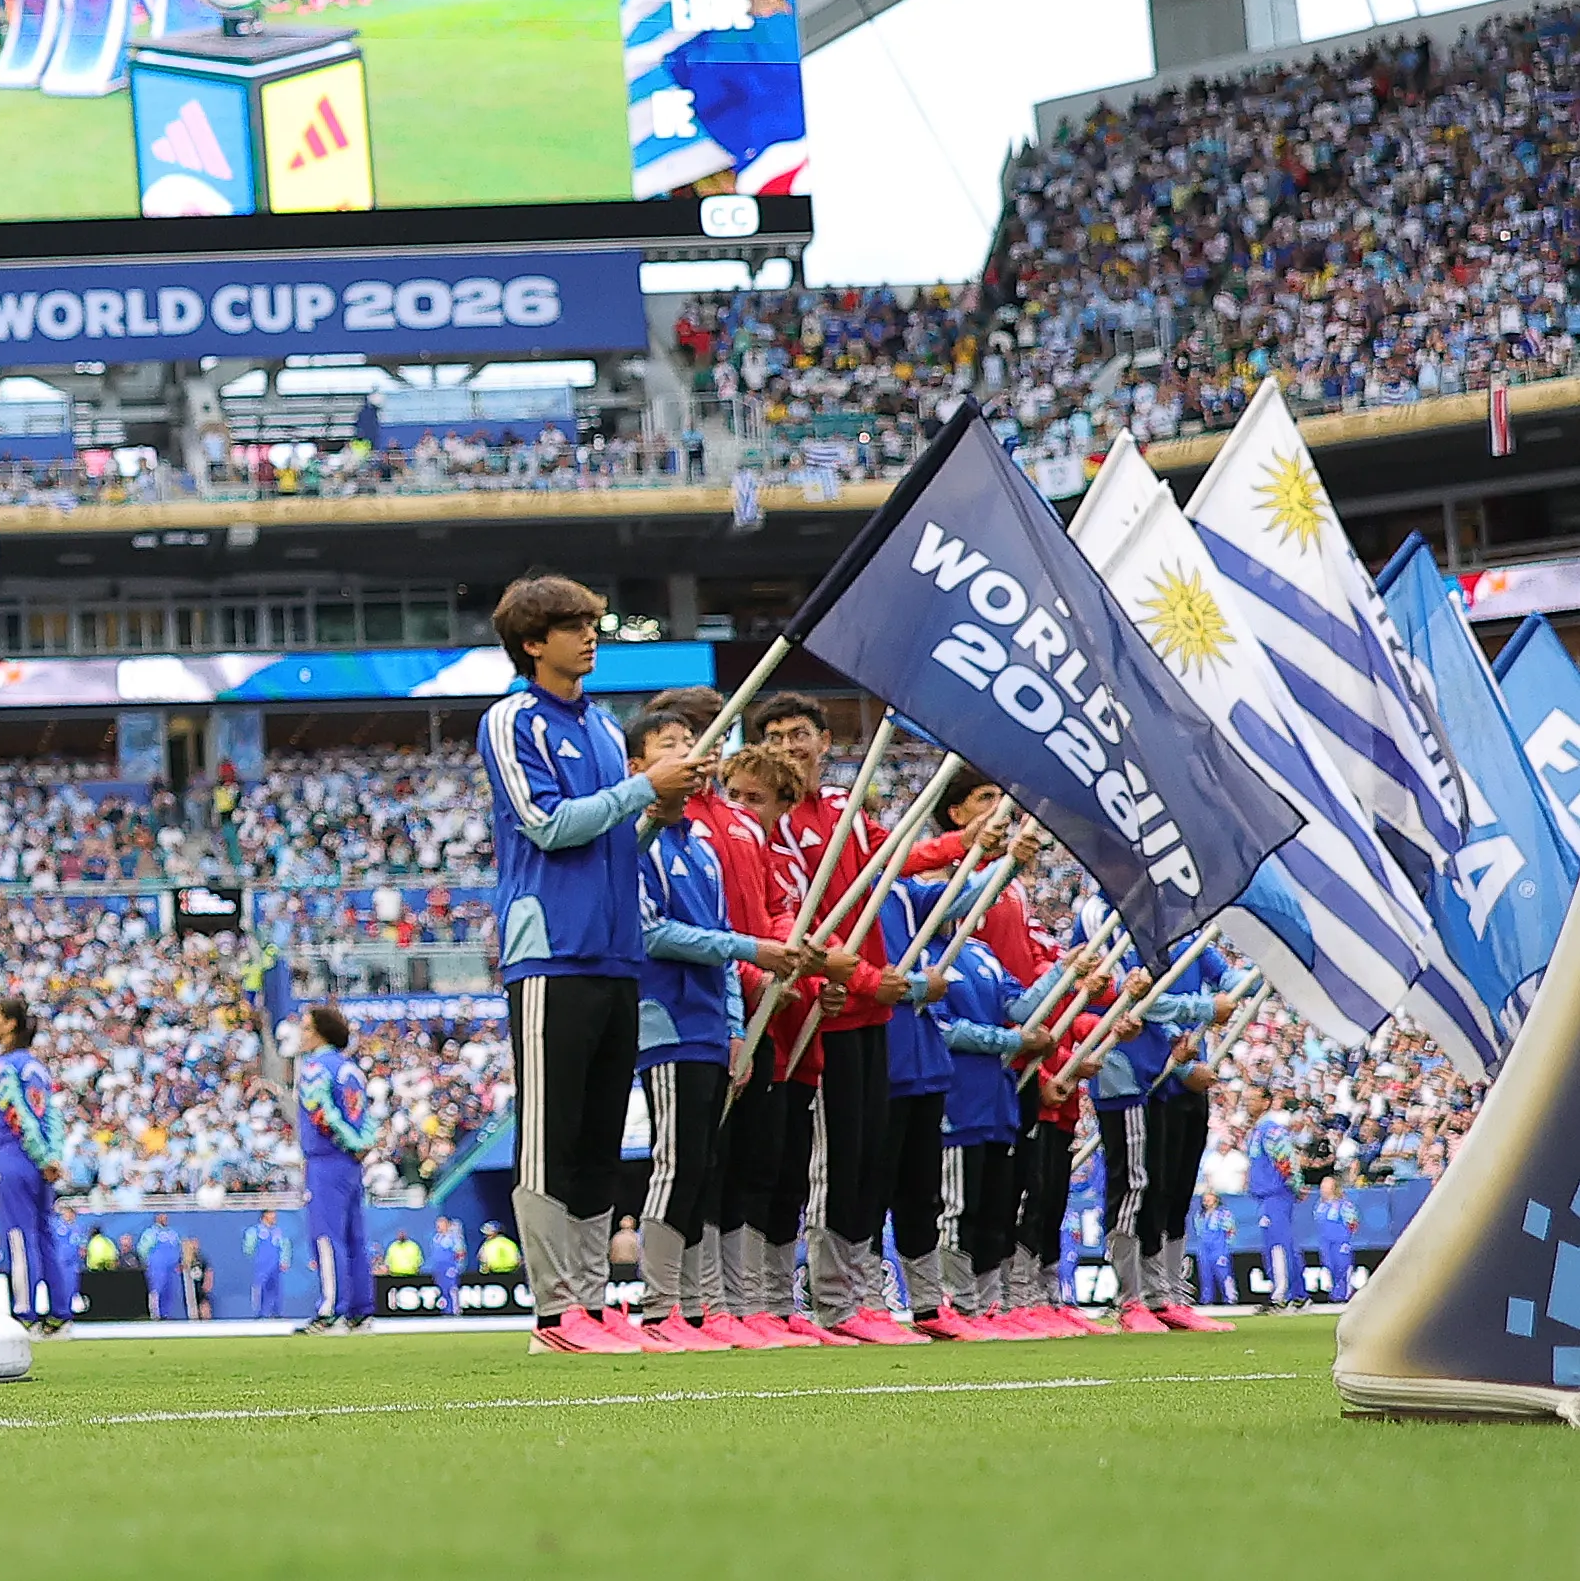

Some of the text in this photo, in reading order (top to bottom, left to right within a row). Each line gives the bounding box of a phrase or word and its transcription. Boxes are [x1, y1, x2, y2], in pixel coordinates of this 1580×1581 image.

[210, 282, 337, 335] CUP
[342, 276, 561, 332] 2026
[910, 521, 1133, 745] WORLD
[930, 621, 1141, 843] 2026
